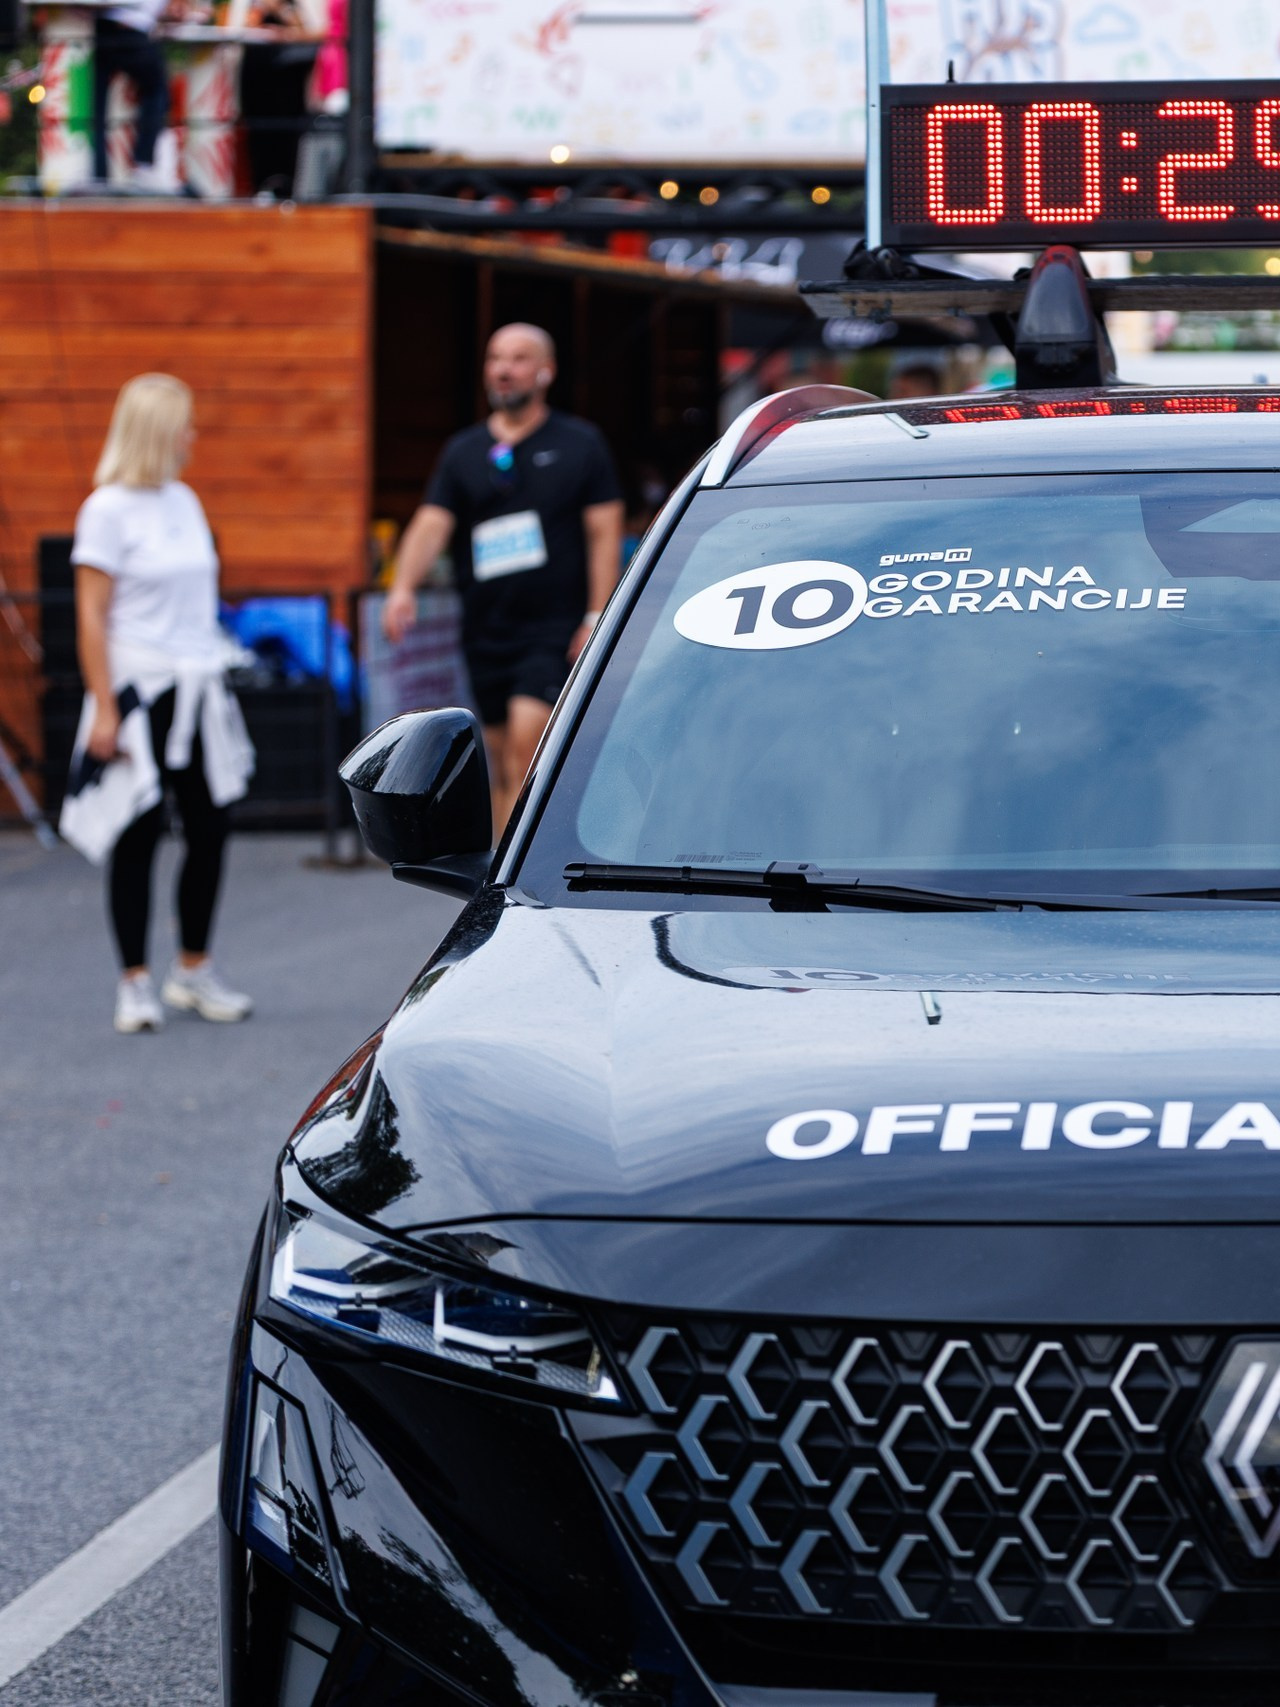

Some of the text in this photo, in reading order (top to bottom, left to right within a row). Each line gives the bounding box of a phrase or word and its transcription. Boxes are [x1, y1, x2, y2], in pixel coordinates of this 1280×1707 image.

[725, 565, 1097, 636] 10 GODINA
[861, 587, 1188, 618] GARANCIJE
